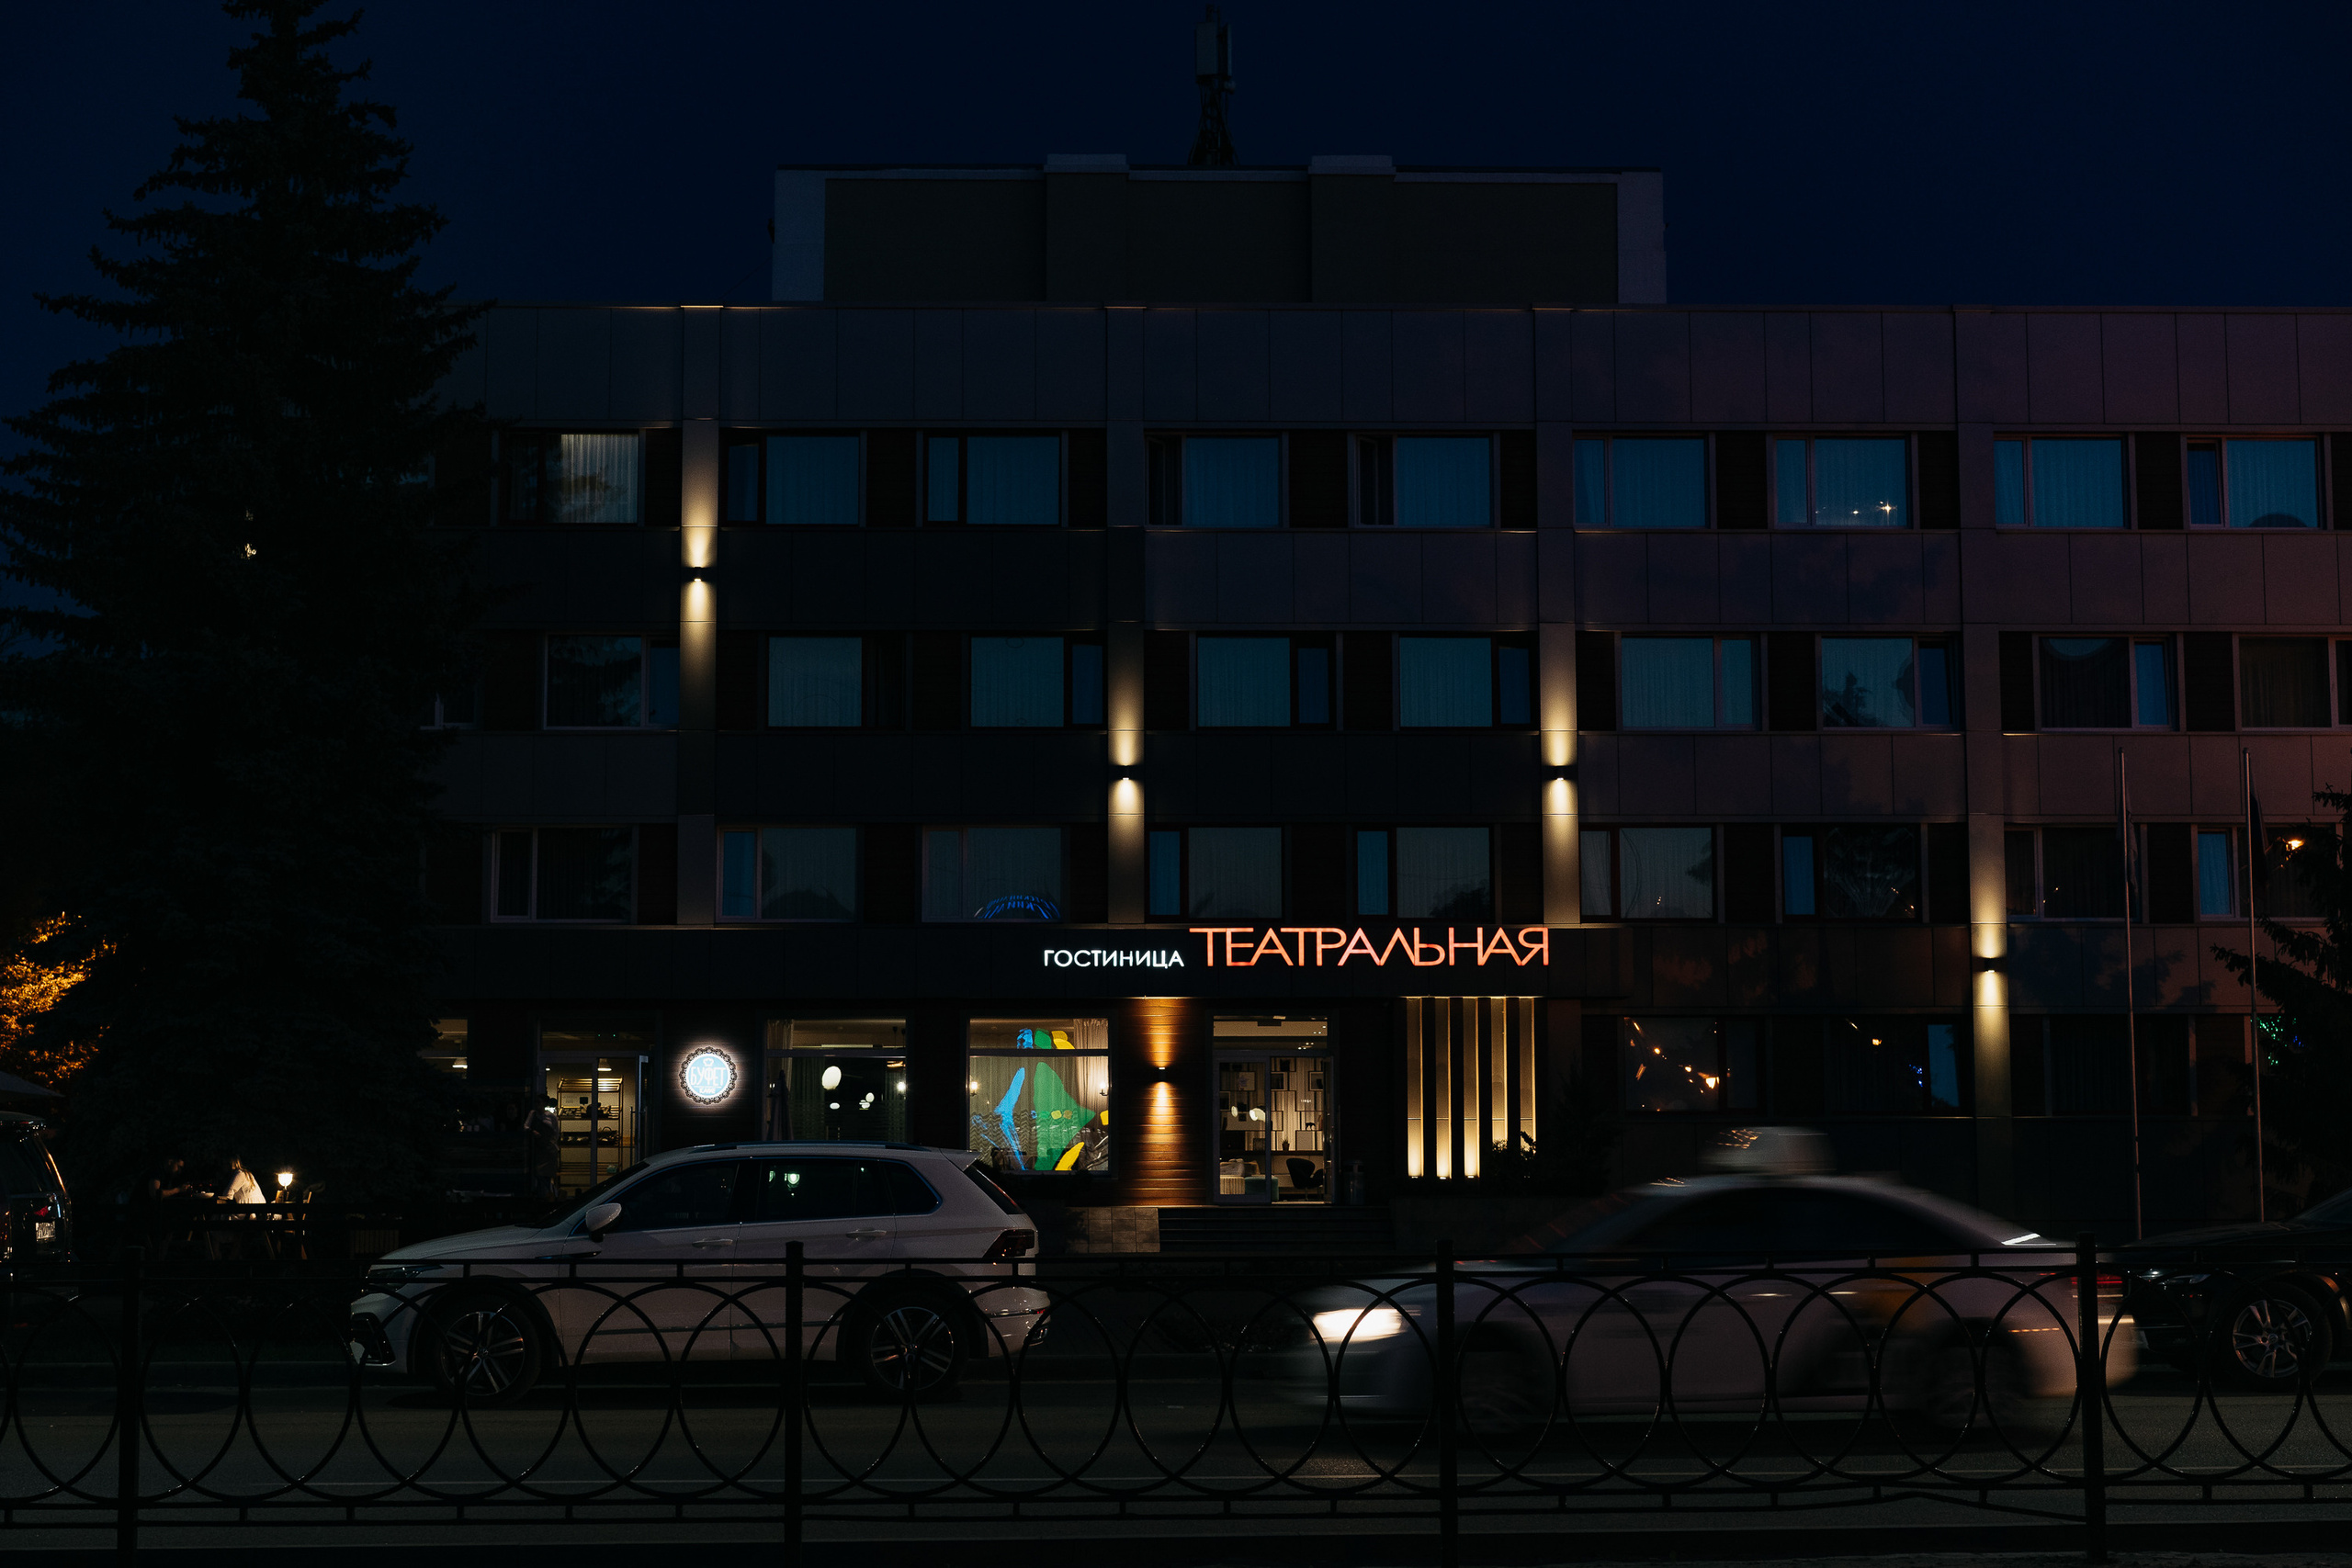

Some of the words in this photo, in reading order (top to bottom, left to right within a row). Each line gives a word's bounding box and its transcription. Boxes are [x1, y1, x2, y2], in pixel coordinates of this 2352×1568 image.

[1043, 949, 1184, 970] ГОСТИНИЦА
[1189, 927, 1550, 967] ТЕАТРАЛЬНАЯ
[690, 1066, 727, 1086] БУФЕТ
